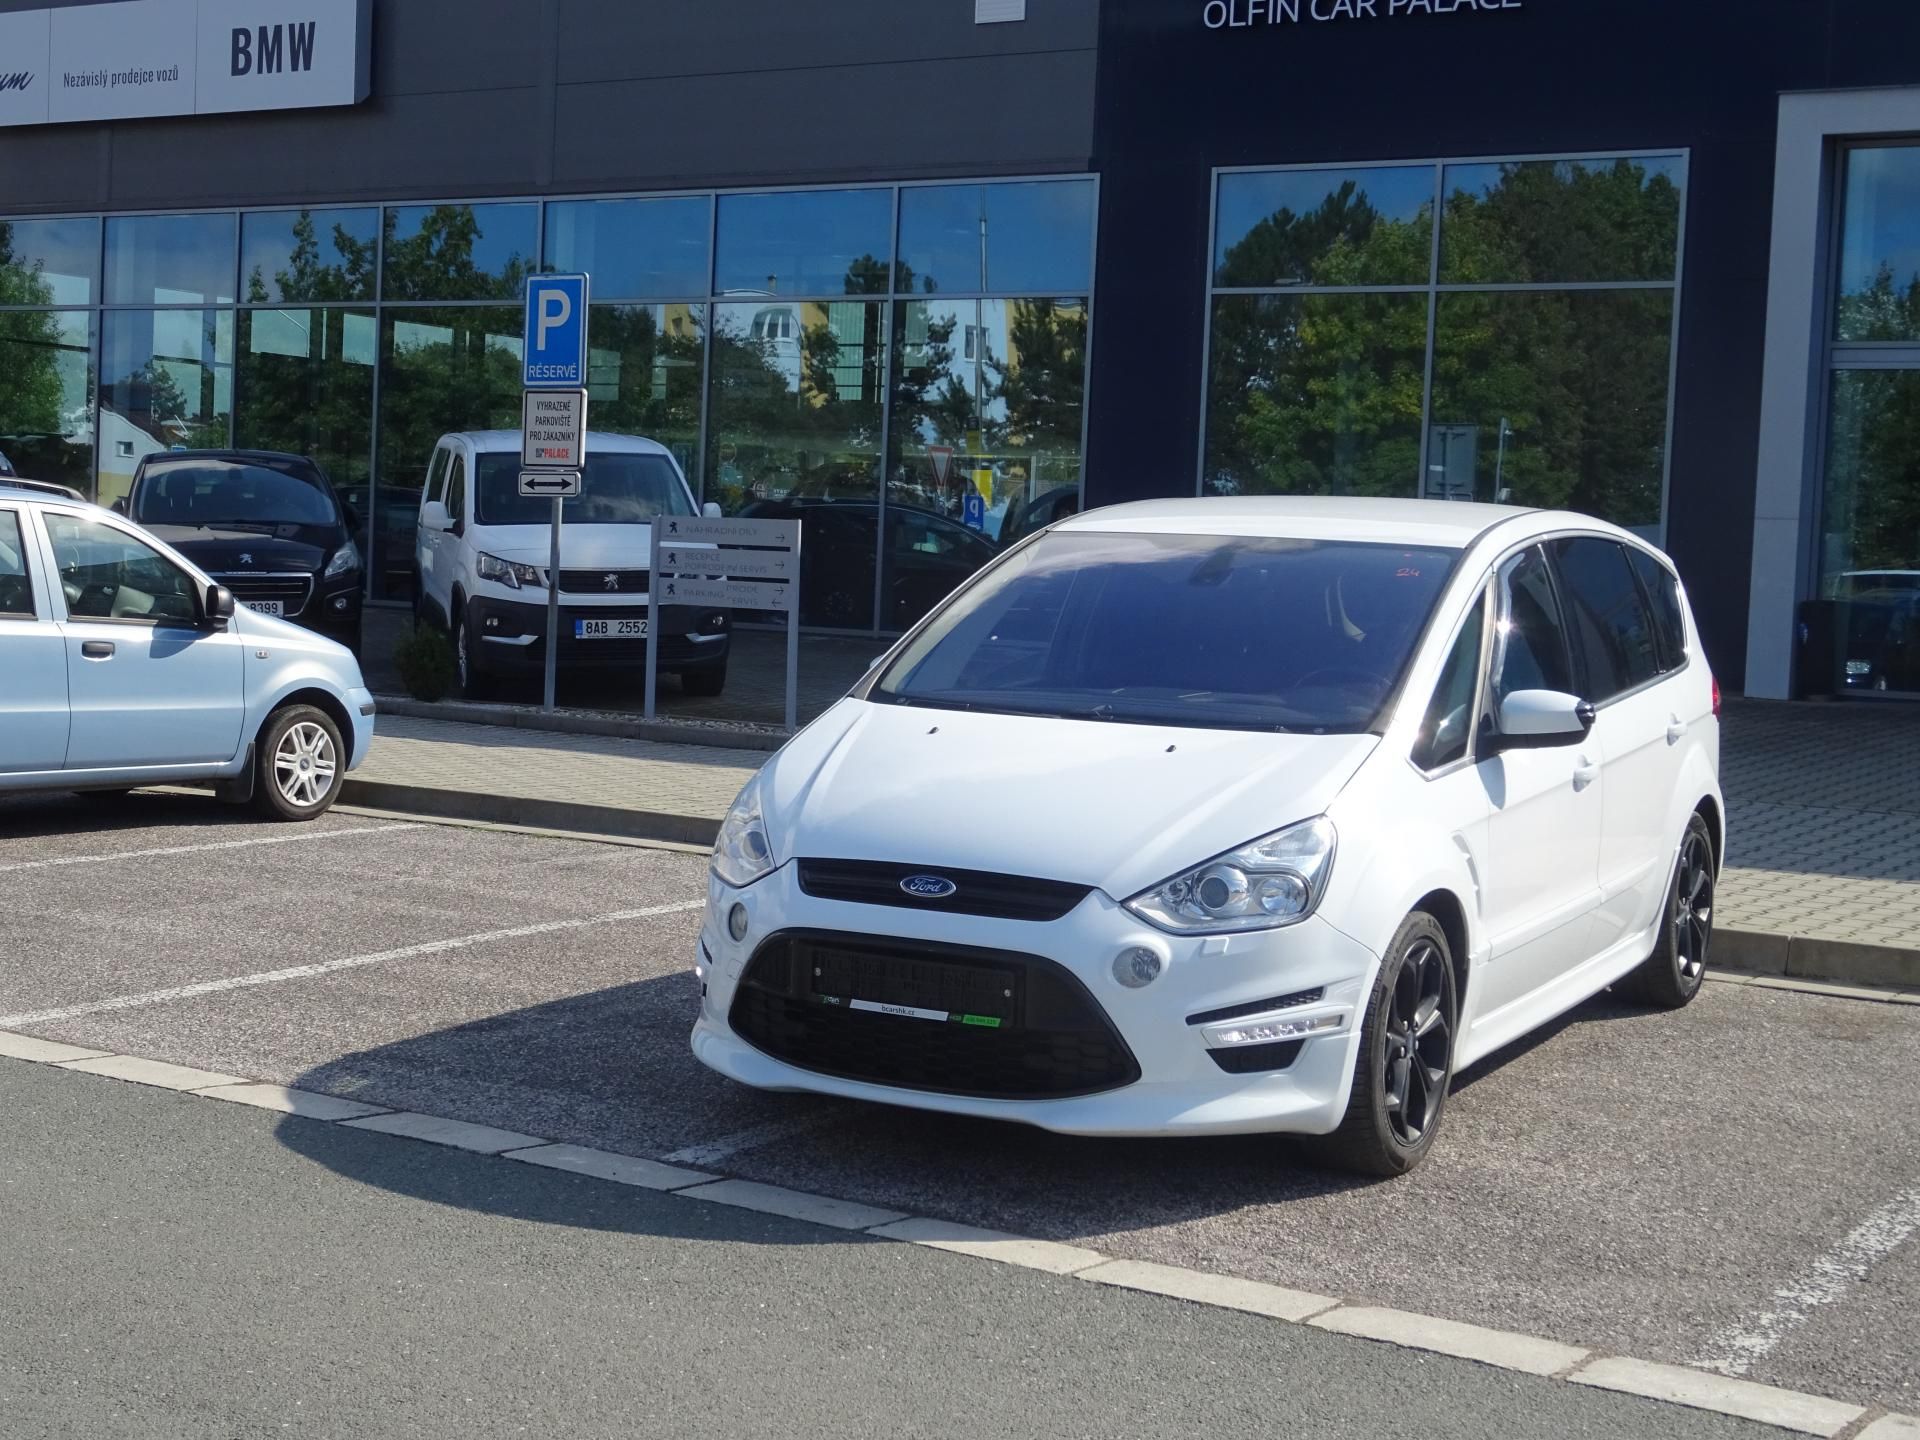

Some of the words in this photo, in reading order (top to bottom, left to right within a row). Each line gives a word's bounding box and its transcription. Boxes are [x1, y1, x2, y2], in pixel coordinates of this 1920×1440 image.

[1203, 0, 1299, 28] OLFIN
[1310, 0, 1377, 21] CAR
[1389, 0, 1522, 15] PAL
[230, 21, 316, 76] BMW
[63, 69, 108, 88] Nezávislý
[111, 68, 154, 88] prodejce
[156, 64, 179, 82] vozů
[536, 289, 571, 350] P
[528, 362, 577, 378] RÉSERVÉ
[529, 430, 542, 441] PRO
[250, 603, 278, 614] 8399
[585, 621, 608, 634] 8AB
[618, 621, 648, 634] 2552
[911, 878, 943, 892] Ford
